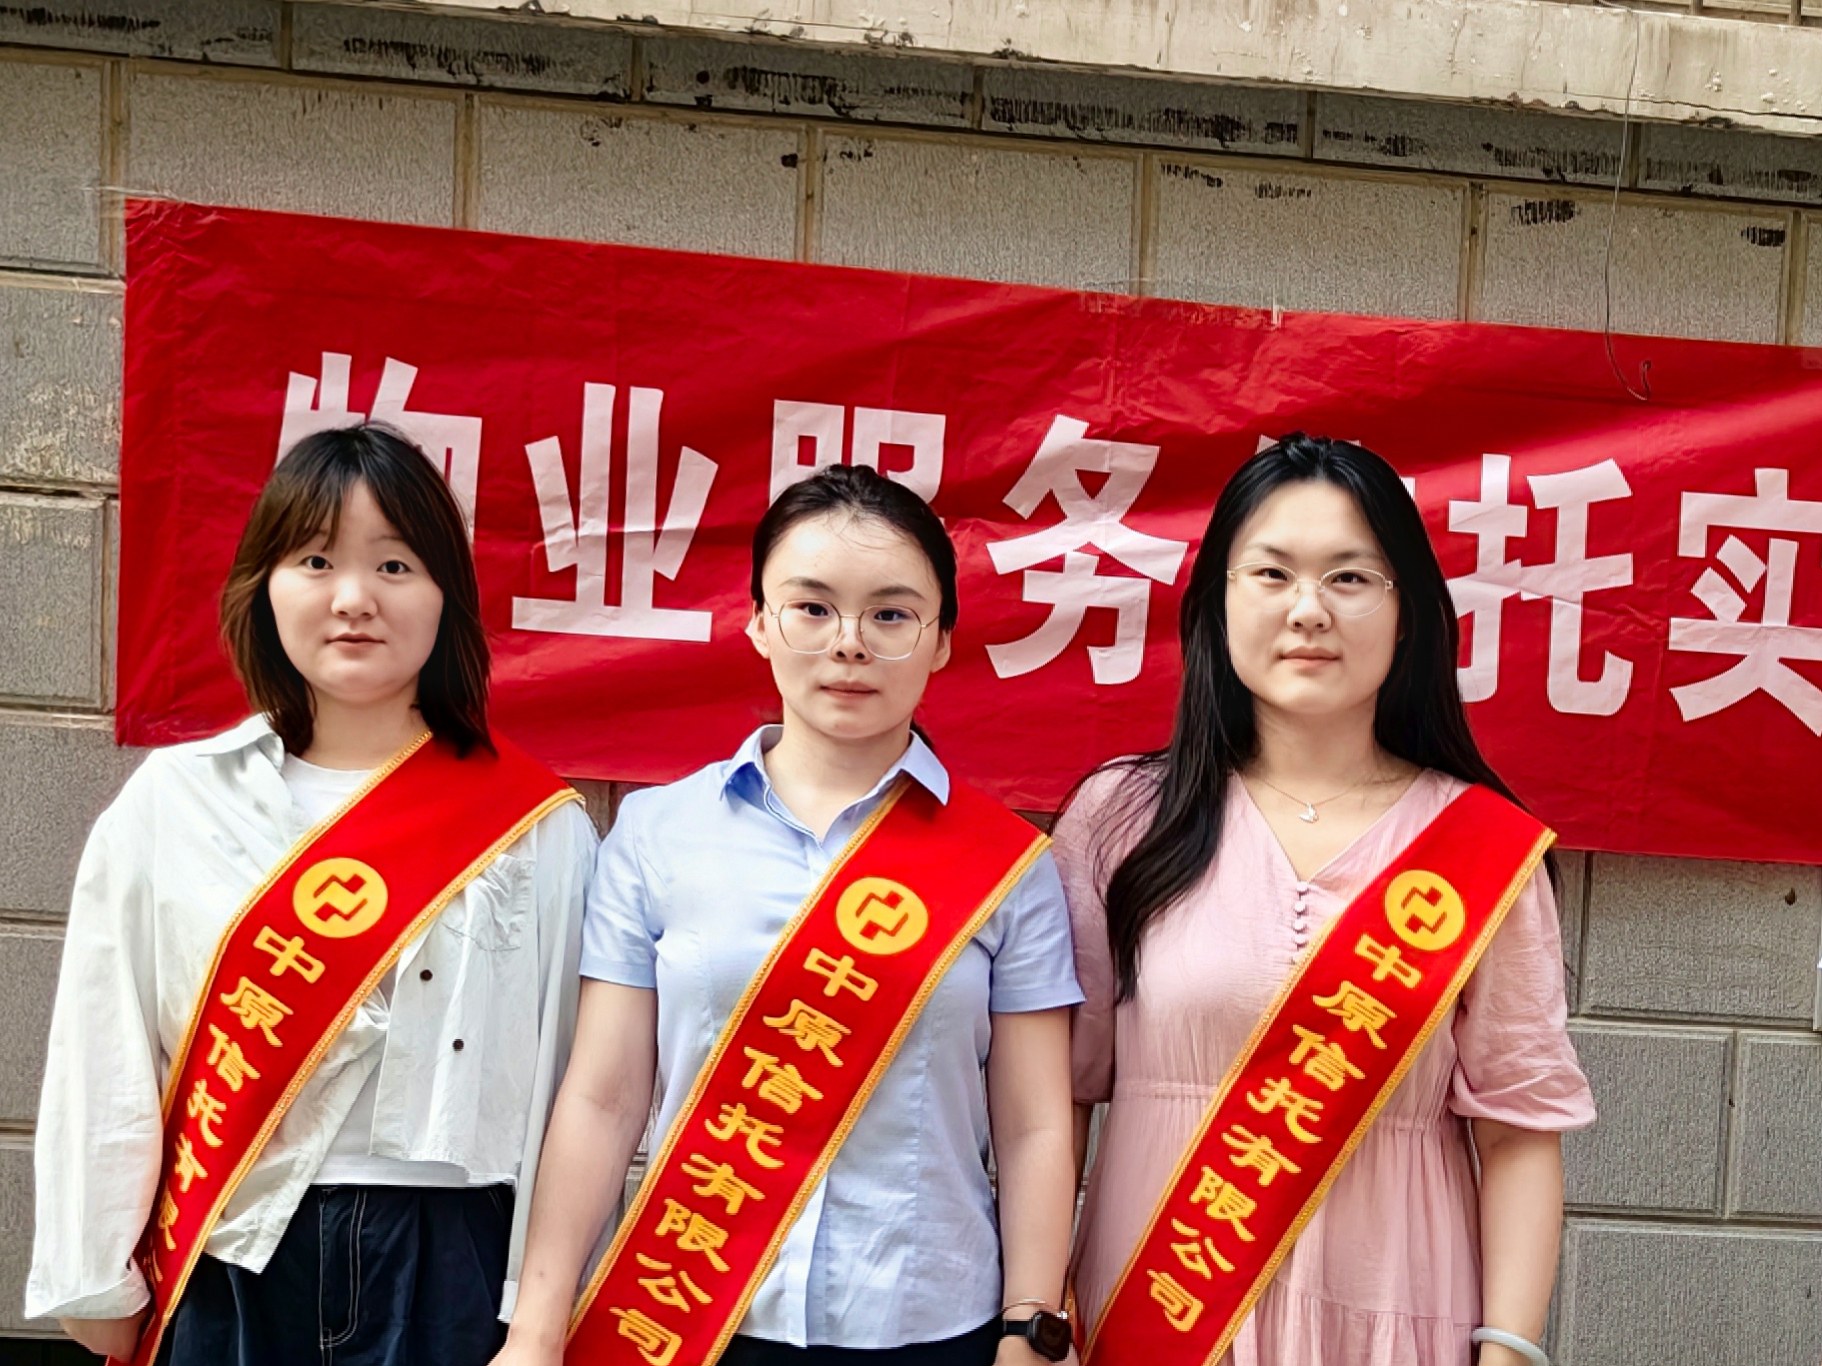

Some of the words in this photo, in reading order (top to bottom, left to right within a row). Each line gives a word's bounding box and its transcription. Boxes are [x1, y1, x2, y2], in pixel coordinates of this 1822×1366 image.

[1145, 934, 1423, 1332] 中原信托有限公司
